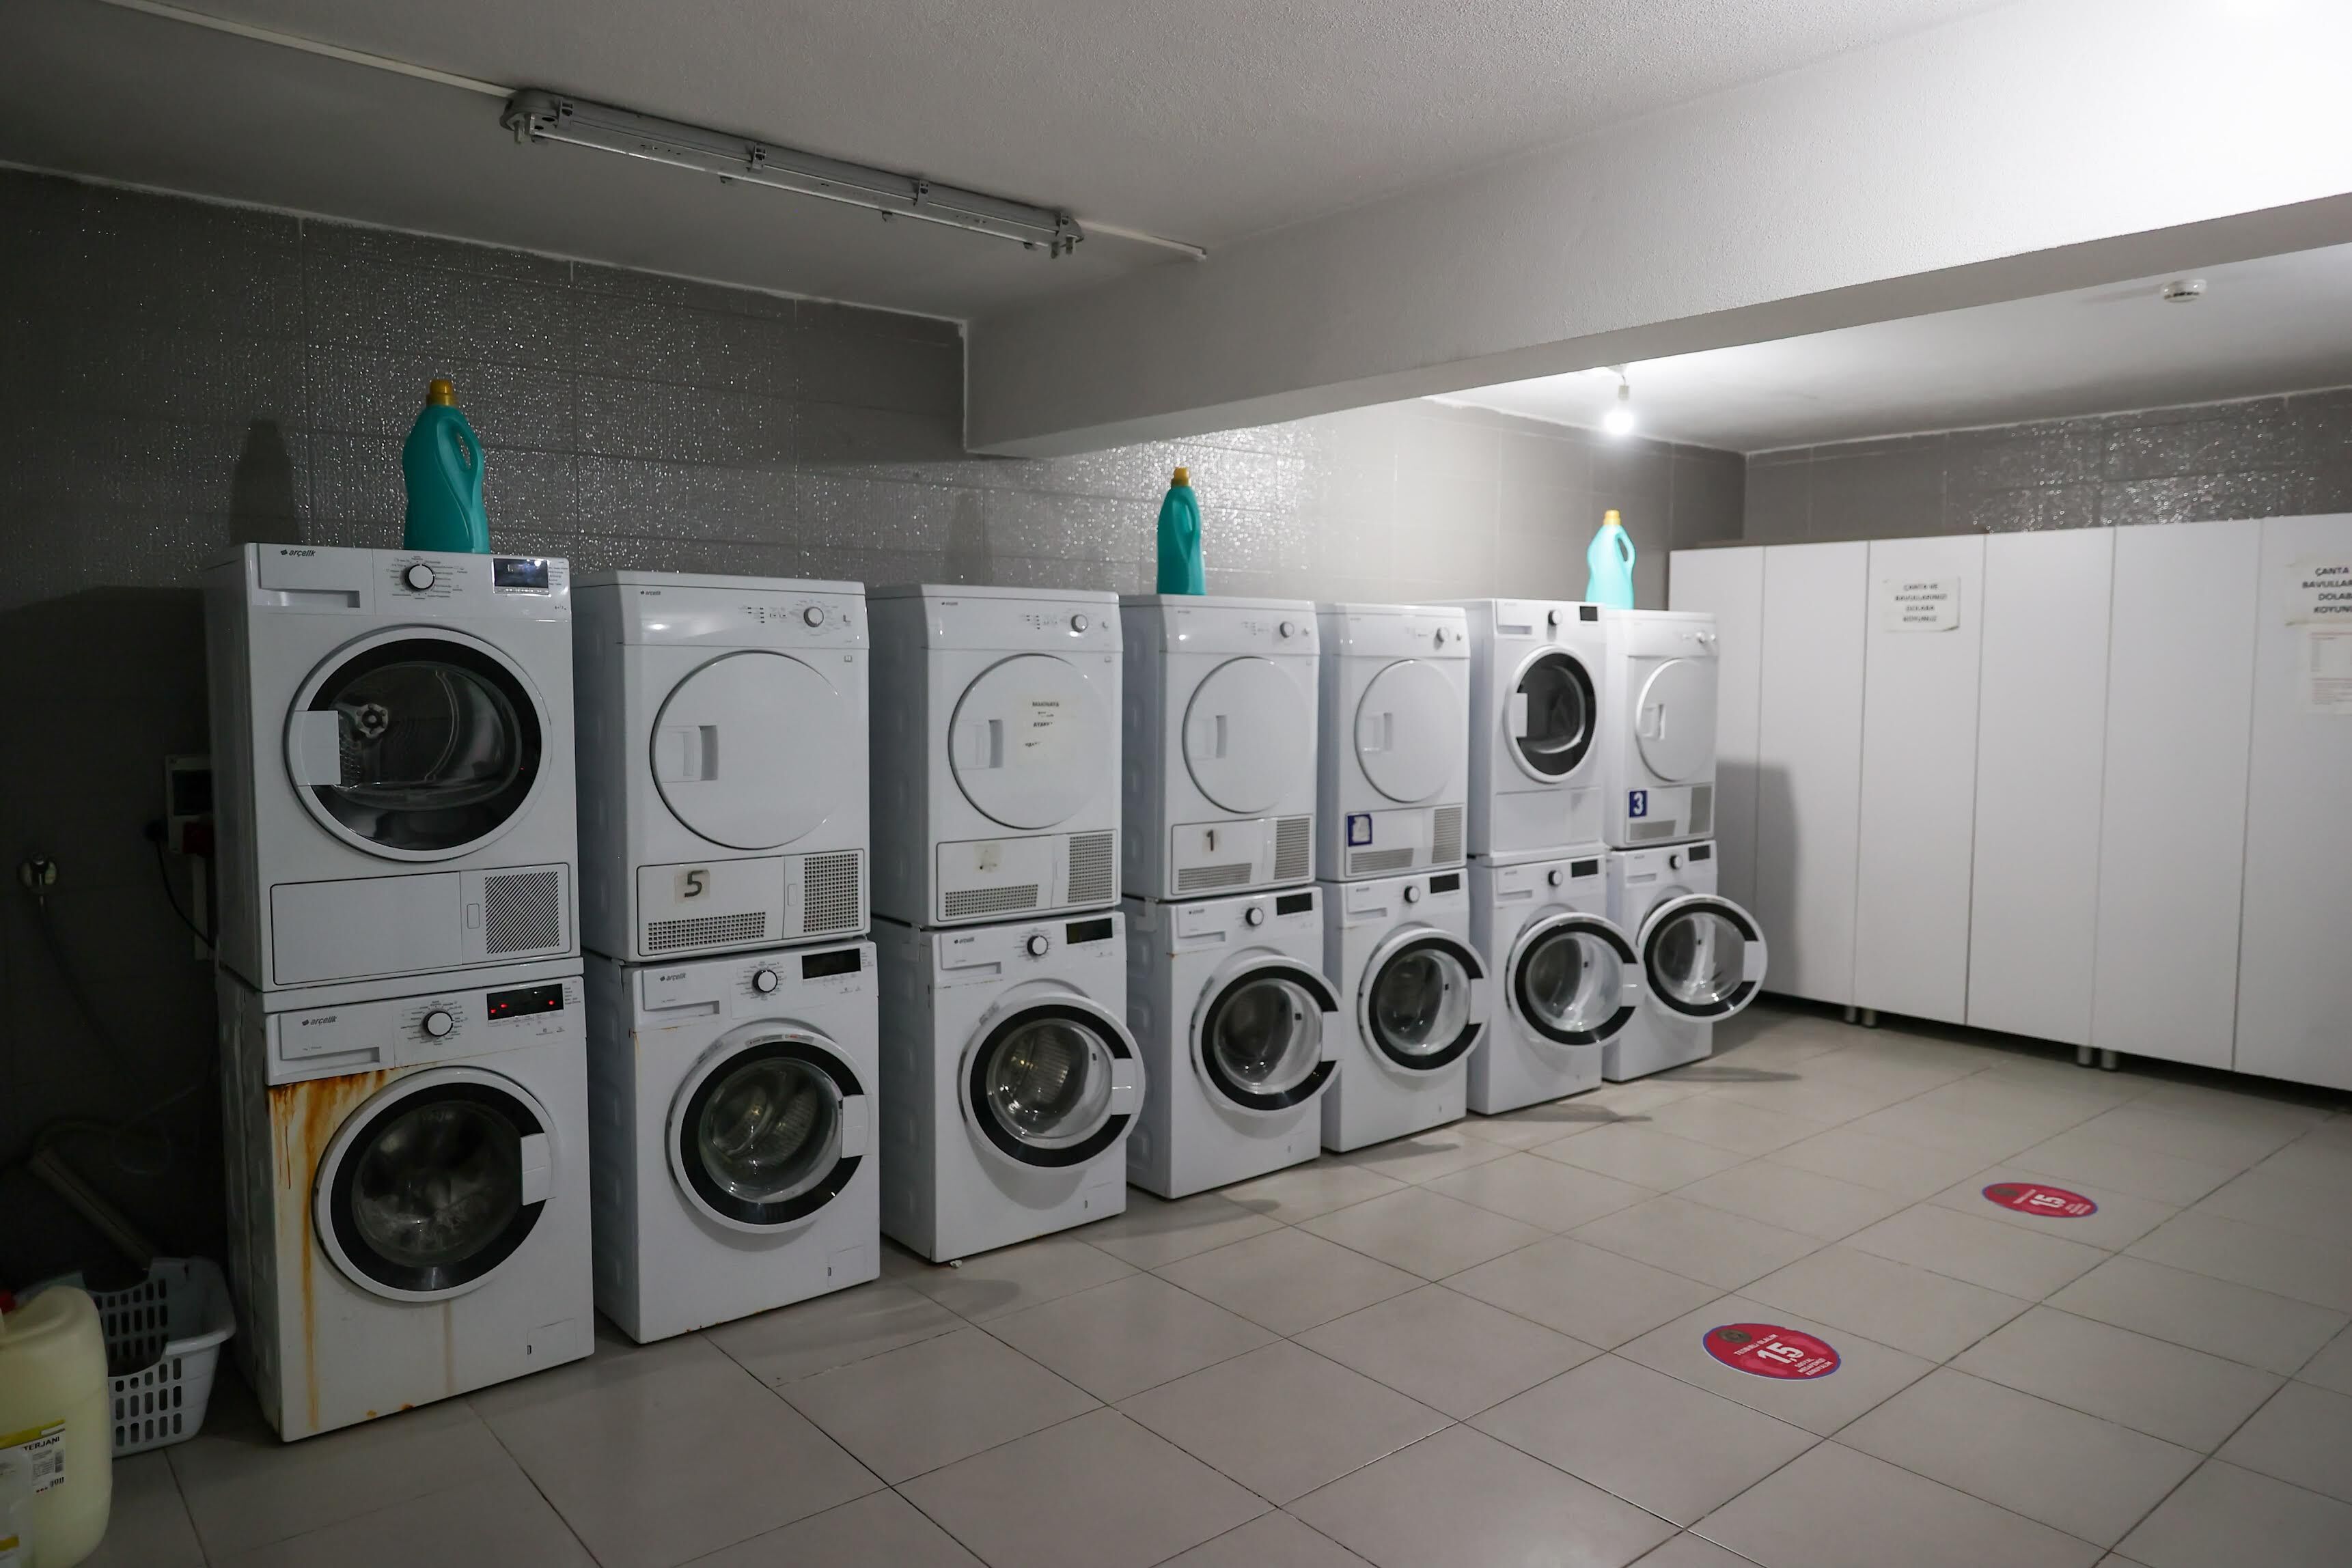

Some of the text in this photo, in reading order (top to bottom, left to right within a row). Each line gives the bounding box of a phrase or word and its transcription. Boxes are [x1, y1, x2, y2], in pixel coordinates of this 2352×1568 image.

[2315, 567, 2349, 576] ÇANTA
[1633, 792, 1644, 815] 3
[1206, 829, 1214, 852] 1
[684, 870, 708, 897] 5
[311, 1016, 337, 1026] arçelik
[1757, 1342, 1804, 1364] 1,5
